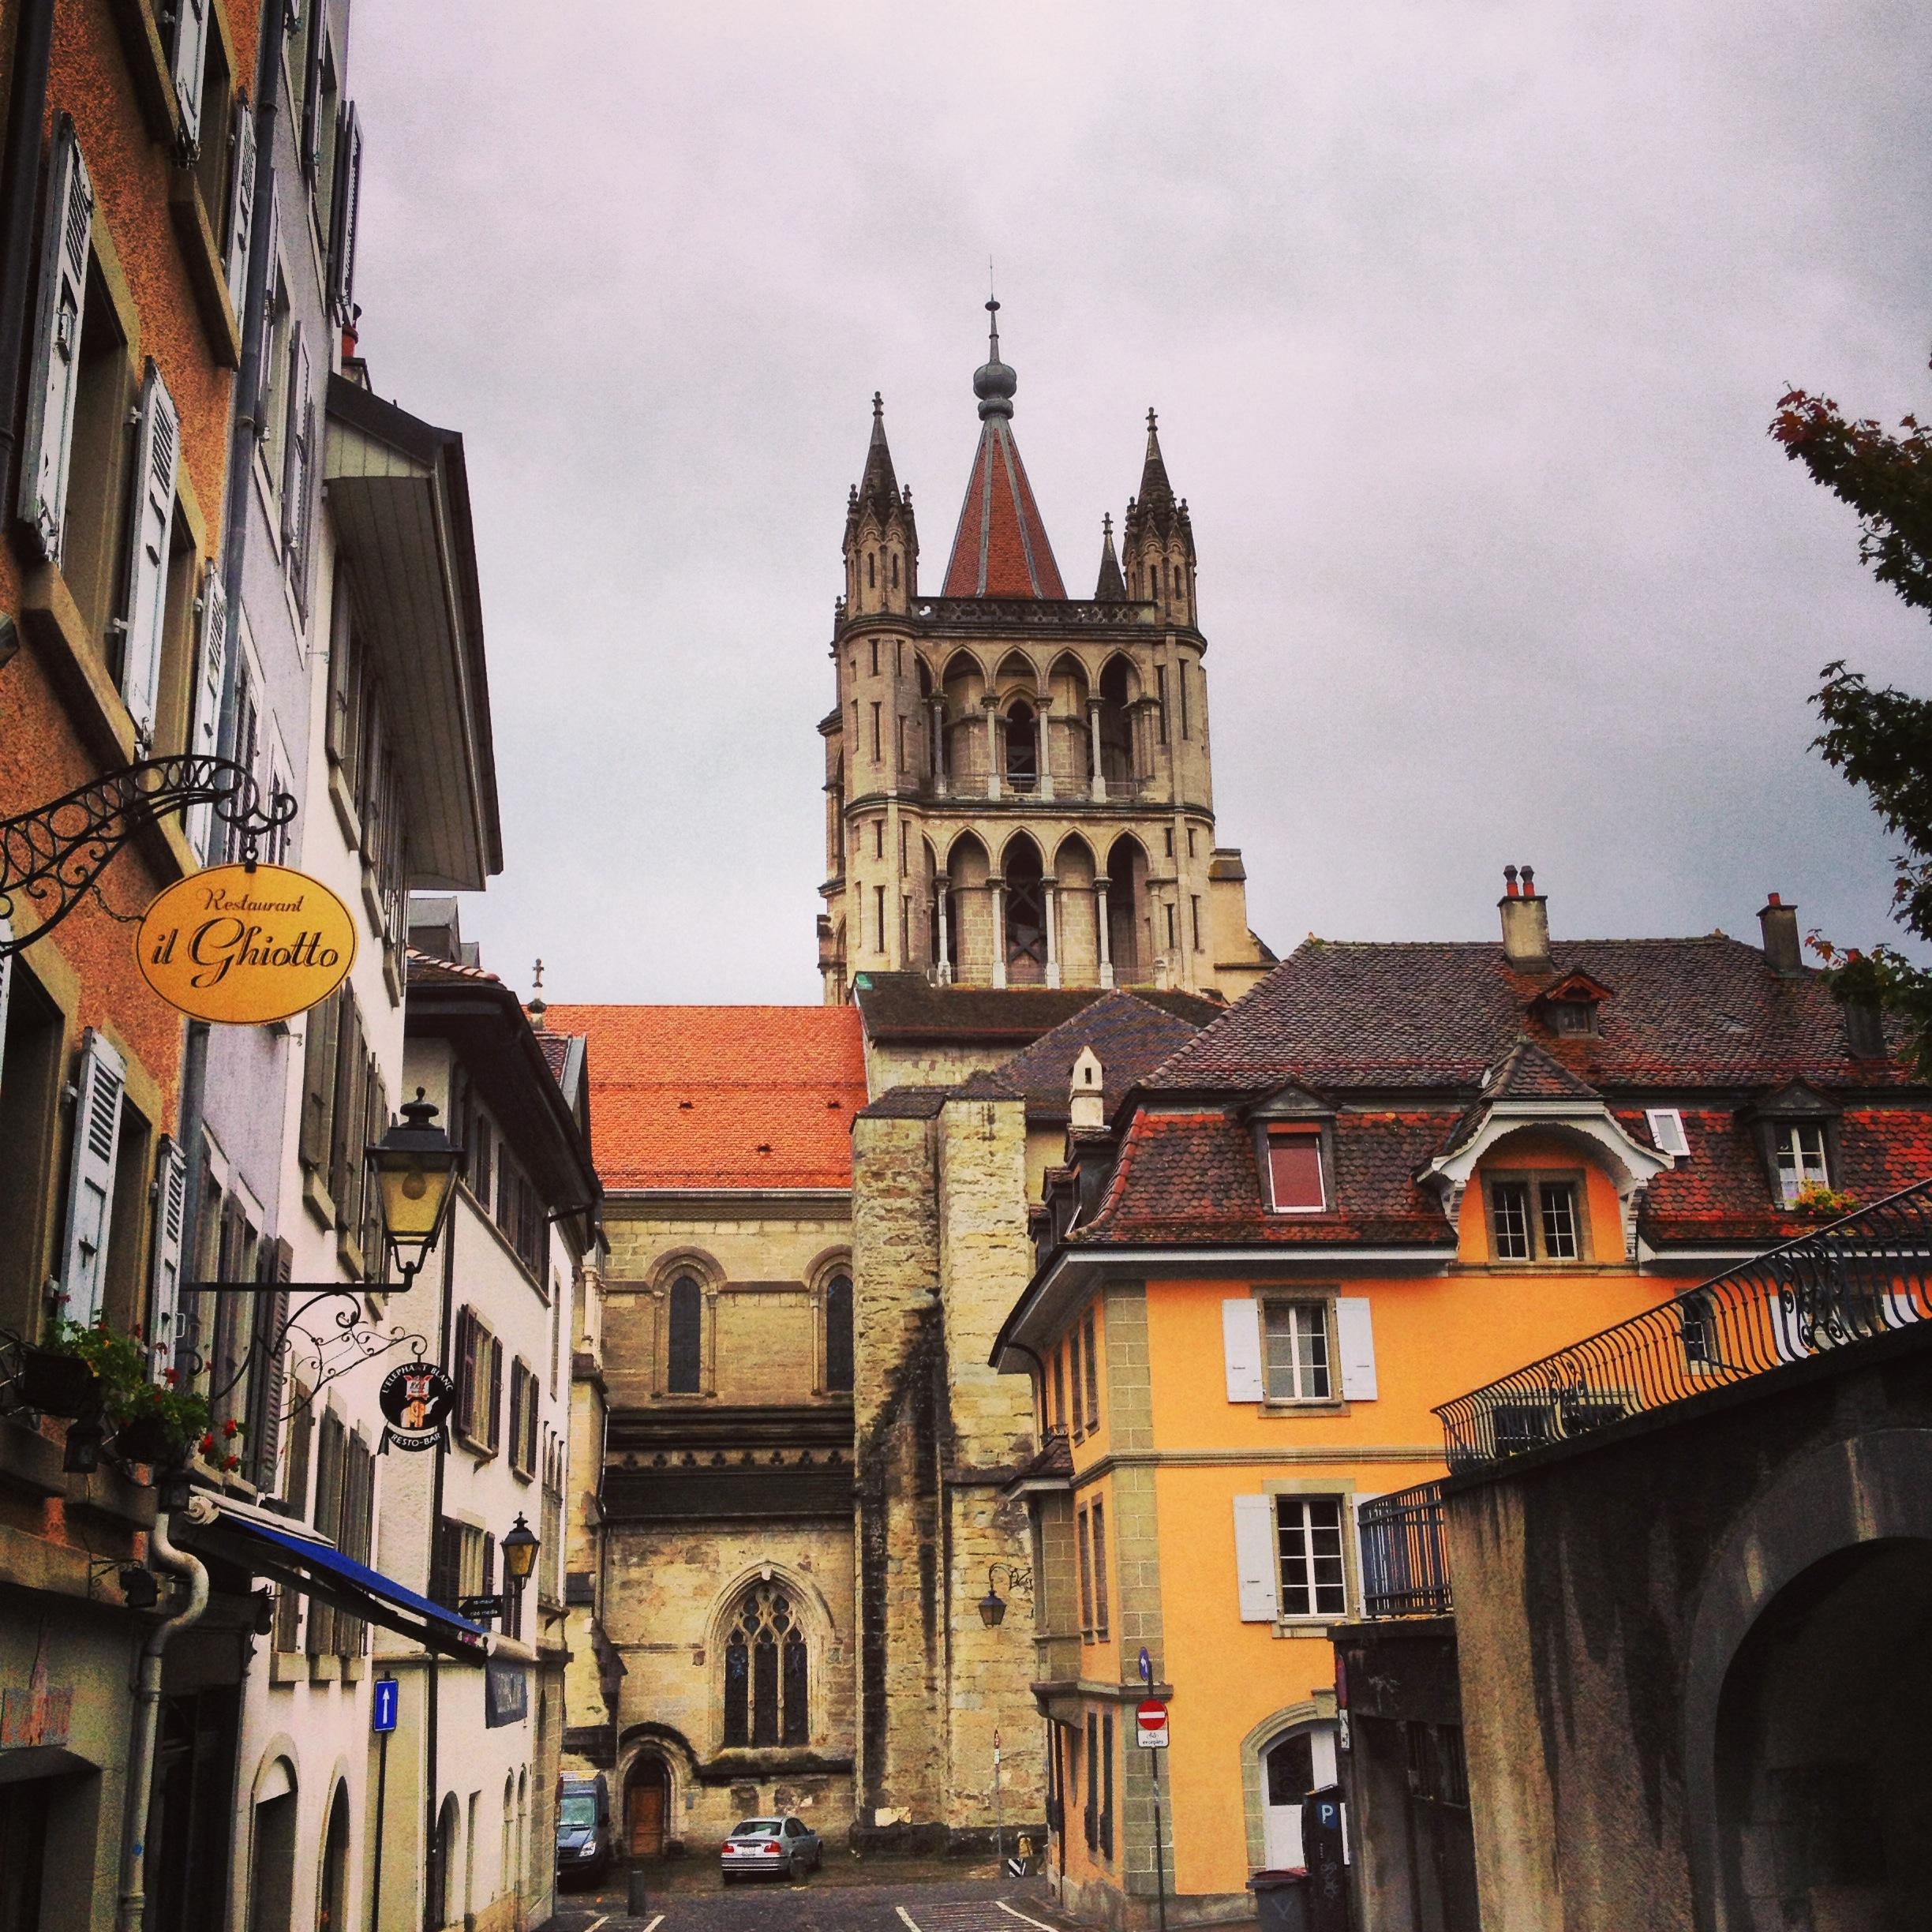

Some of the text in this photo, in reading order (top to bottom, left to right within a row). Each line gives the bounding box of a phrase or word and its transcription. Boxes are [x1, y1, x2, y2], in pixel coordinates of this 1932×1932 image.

[196, 888, 305, 912] Restaurant
[151, 916, 339, 988] il Ghiotto
[381, 1364, 428, 1394] L'ELEPHAT
[430, 1367, 454, 1392] BLANC
[391, 1432, 442, 1447] RESTO-BAR
[1321, 1804, 1334, 1824] P
